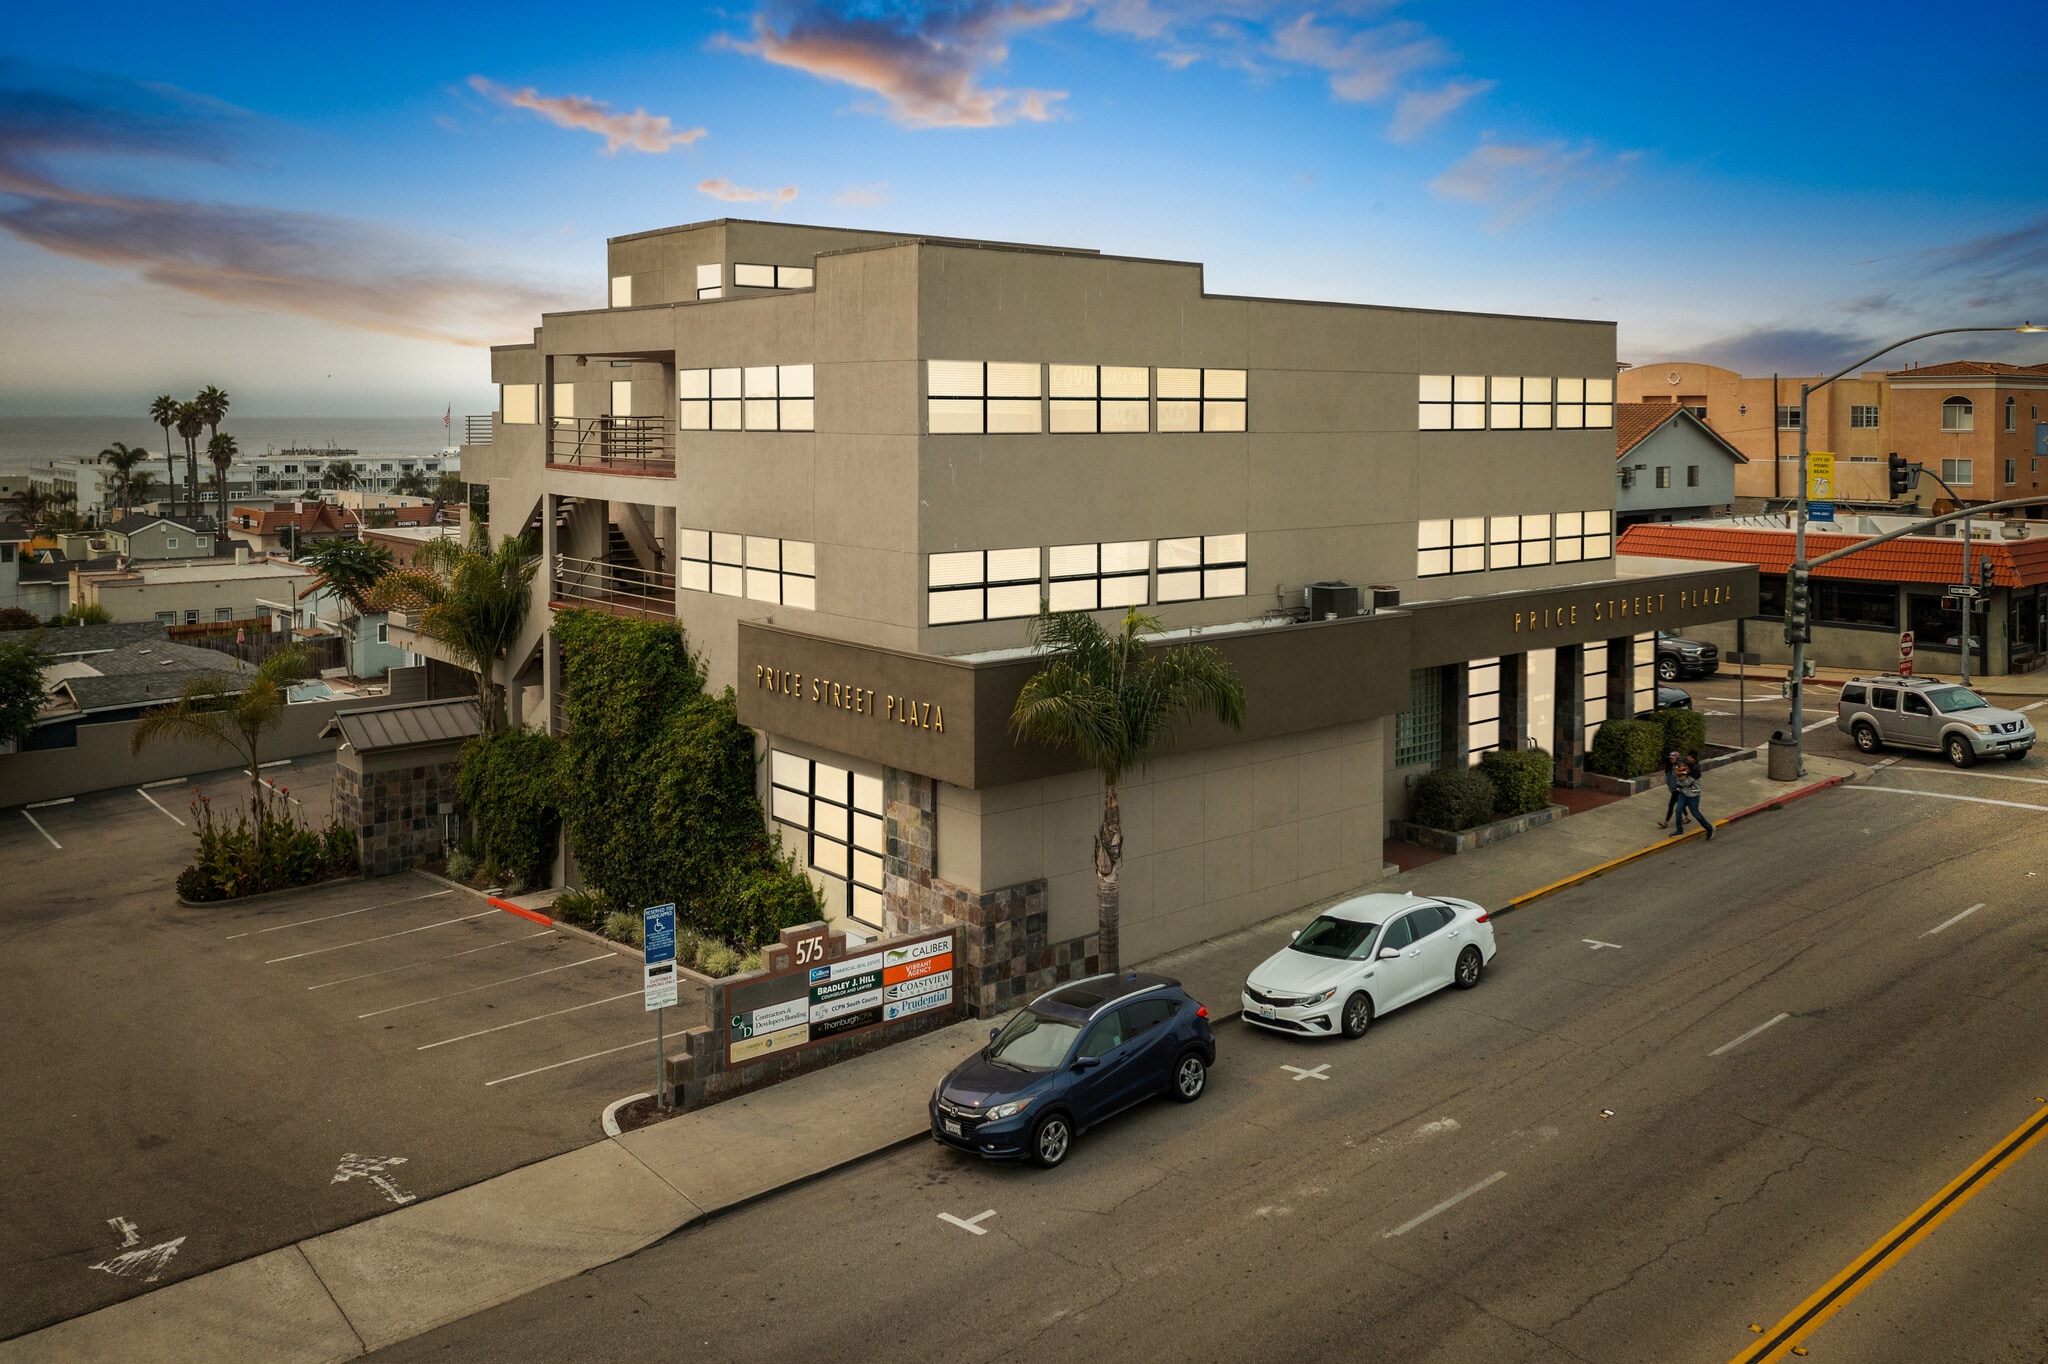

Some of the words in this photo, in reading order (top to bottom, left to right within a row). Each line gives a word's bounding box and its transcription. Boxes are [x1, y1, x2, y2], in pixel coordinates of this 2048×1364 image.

[1514, 605, 1577, 633] PRICE
[1594, 594, 1664, 621] STREET
[1681, 586, 1731, 609] PLAZA
[757, 665, 802, 698] PRICE
[812, 678, 874, 716] STREET
[887, 695, 944, 733] PLAZA
[796, 936, 823, 965] 575
[912, 940, 949, 957] CALIBER
[905, 959, 932, 972] VIBRANT
[907, 966, 932, 977] AGENCY
[817, 981, 850, 995] BRADLEY
[852, 978, 858, 987] J.
[859, 974, 876, 985] HILL
[900, 972, 950, 992] COASTVIEW
[821, 989, 846, 1000] COUNSELOR
[857, 983, 872, 991] LAWYER
[902, 989, 948, 1011] Prudential
[831, 1003, 846, 1012] CCPN
[846, 999, 861, 1008] South
[861, 995, 878, 1004] County
[755, 1009, 786, 1021] Contractors
[755, 1018, 784, 1029] Developers
[784, 1011, 807, 1022] Bonding
